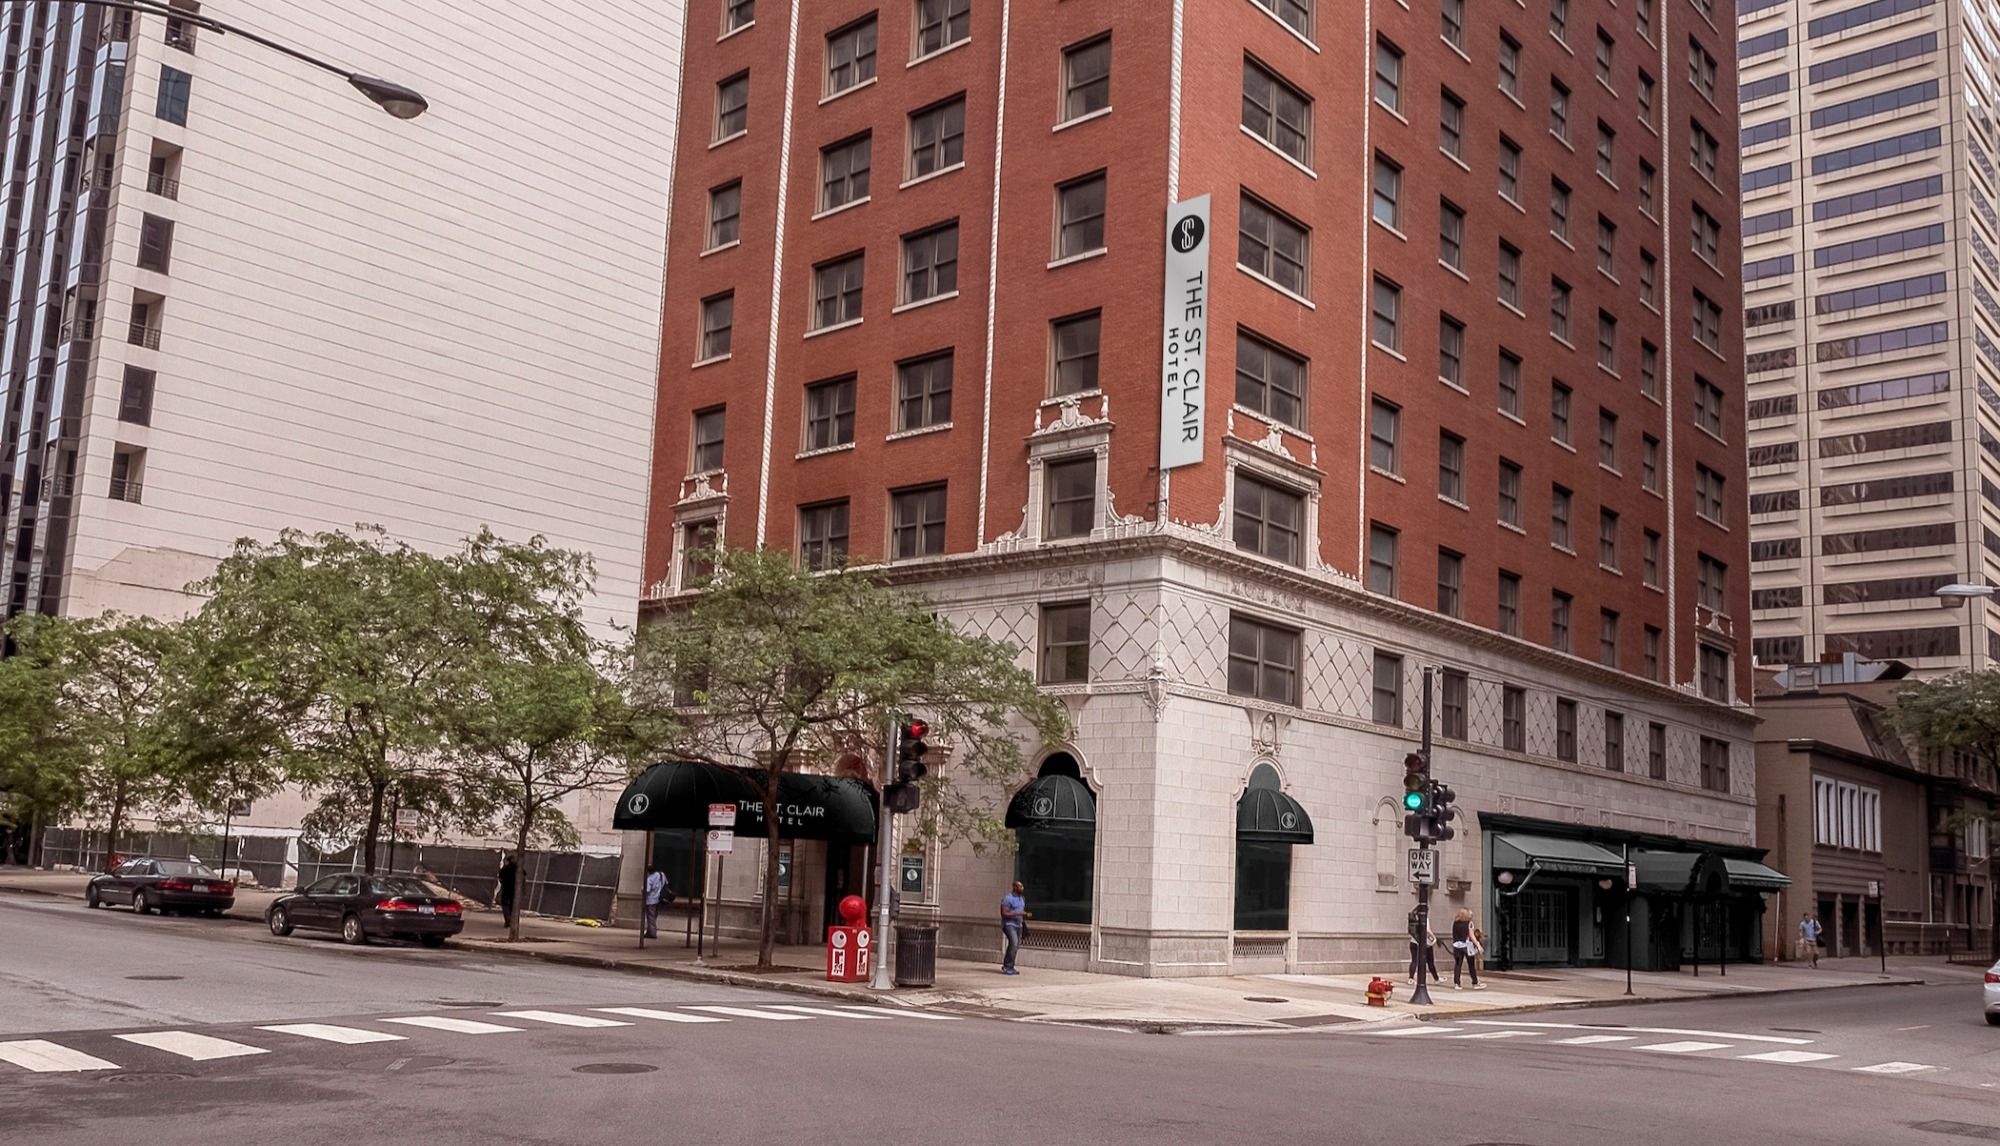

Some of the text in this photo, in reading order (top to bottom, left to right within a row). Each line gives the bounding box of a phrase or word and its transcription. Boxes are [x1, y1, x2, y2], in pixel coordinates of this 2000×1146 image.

[1167, 327, 1179, 397] HOTEL
[1182, 270, 1203, 443] THE ST. CLAIR
[739, 800, 763, 813] THE
[787, 804, 825, 818] CLAIR
[756, 815, 803, 826] HTEL
[1411, 852, 1431, 861] ONE
[1411, 861, 1431, 870] WAY
